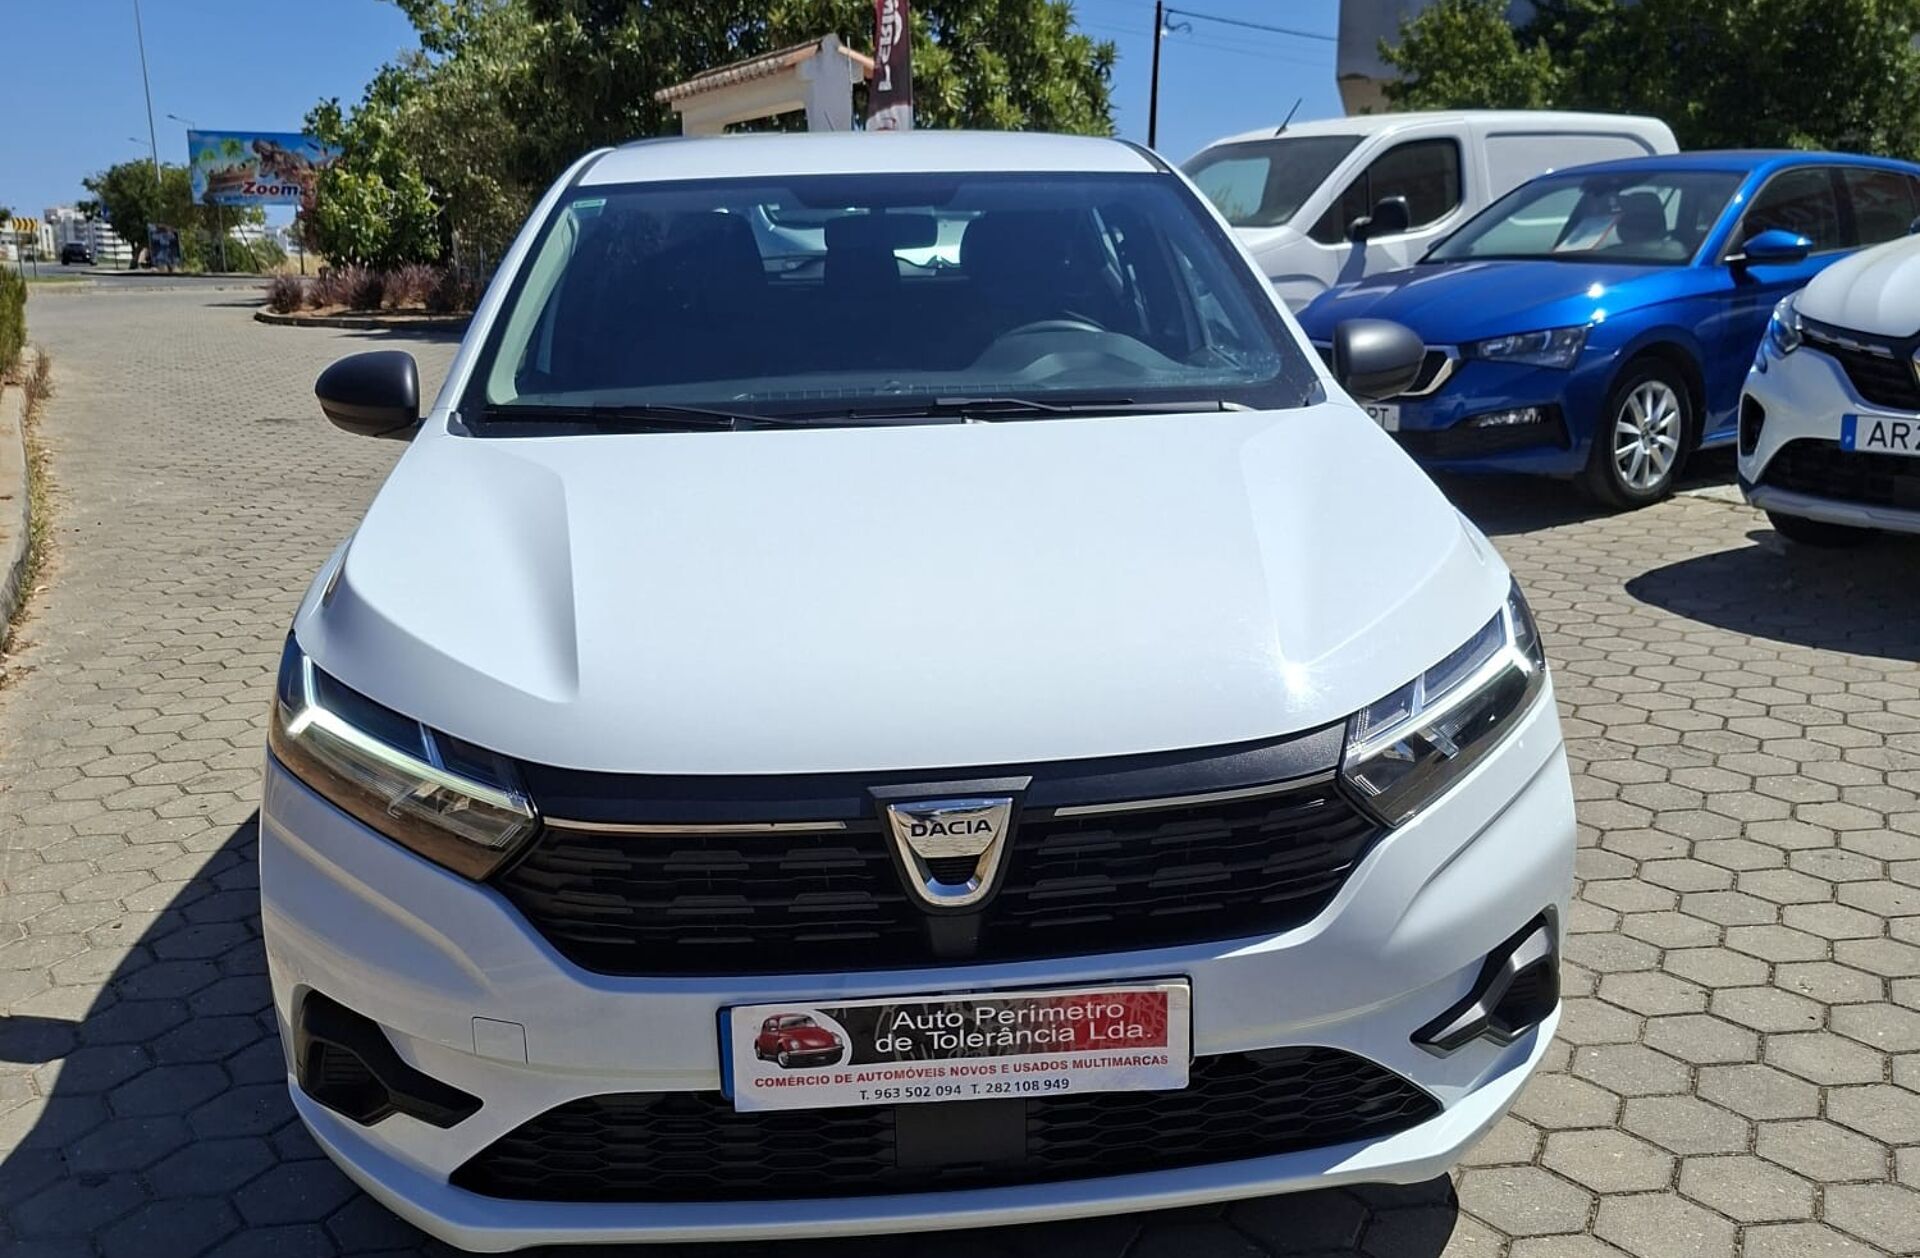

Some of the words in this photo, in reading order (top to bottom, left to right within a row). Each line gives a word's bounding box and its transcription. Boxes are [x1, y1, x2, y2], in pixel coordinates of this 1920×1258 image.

[242, 181, 303, 195] Zoom
[910, 819, 992, 837] DACIA
[891, 1010, 964, 1030] Auto
[976, 1001, 1125, 1025] Perímetro
[875, 1032, 913, 1054] de
[925, 1026, 1076, 1050] Tolerância
[1089, 1020, 1152, 1041] Lda.
[754, 1072, 830, 1088] COMÉRCIO
[834, 1073, 852, 1084] DE
[856, 1065, 946, 1083] AUTOMÓVEIS
[949, 1064, 997, 1077] NOVOS
[1001, 1063, 1008, 1074] E
[1013, 1060, 1068, 1073] USADOS
[1072, 1055, 1168, 1070] MULTIMARCAS
[860, 1089, 869, 1101] T.
[874, 1087, 901, 1100] 963
[905, 1086, 931, 1098] 502
[935, 1084, 962, 1096] 094
[970, 1083, 980, 1095] T.
[986, 1082, 1011, 1093] 282
[1014, 1080, 1040, 1092] 108
[1043, 1078, 1070, 1090] 949
